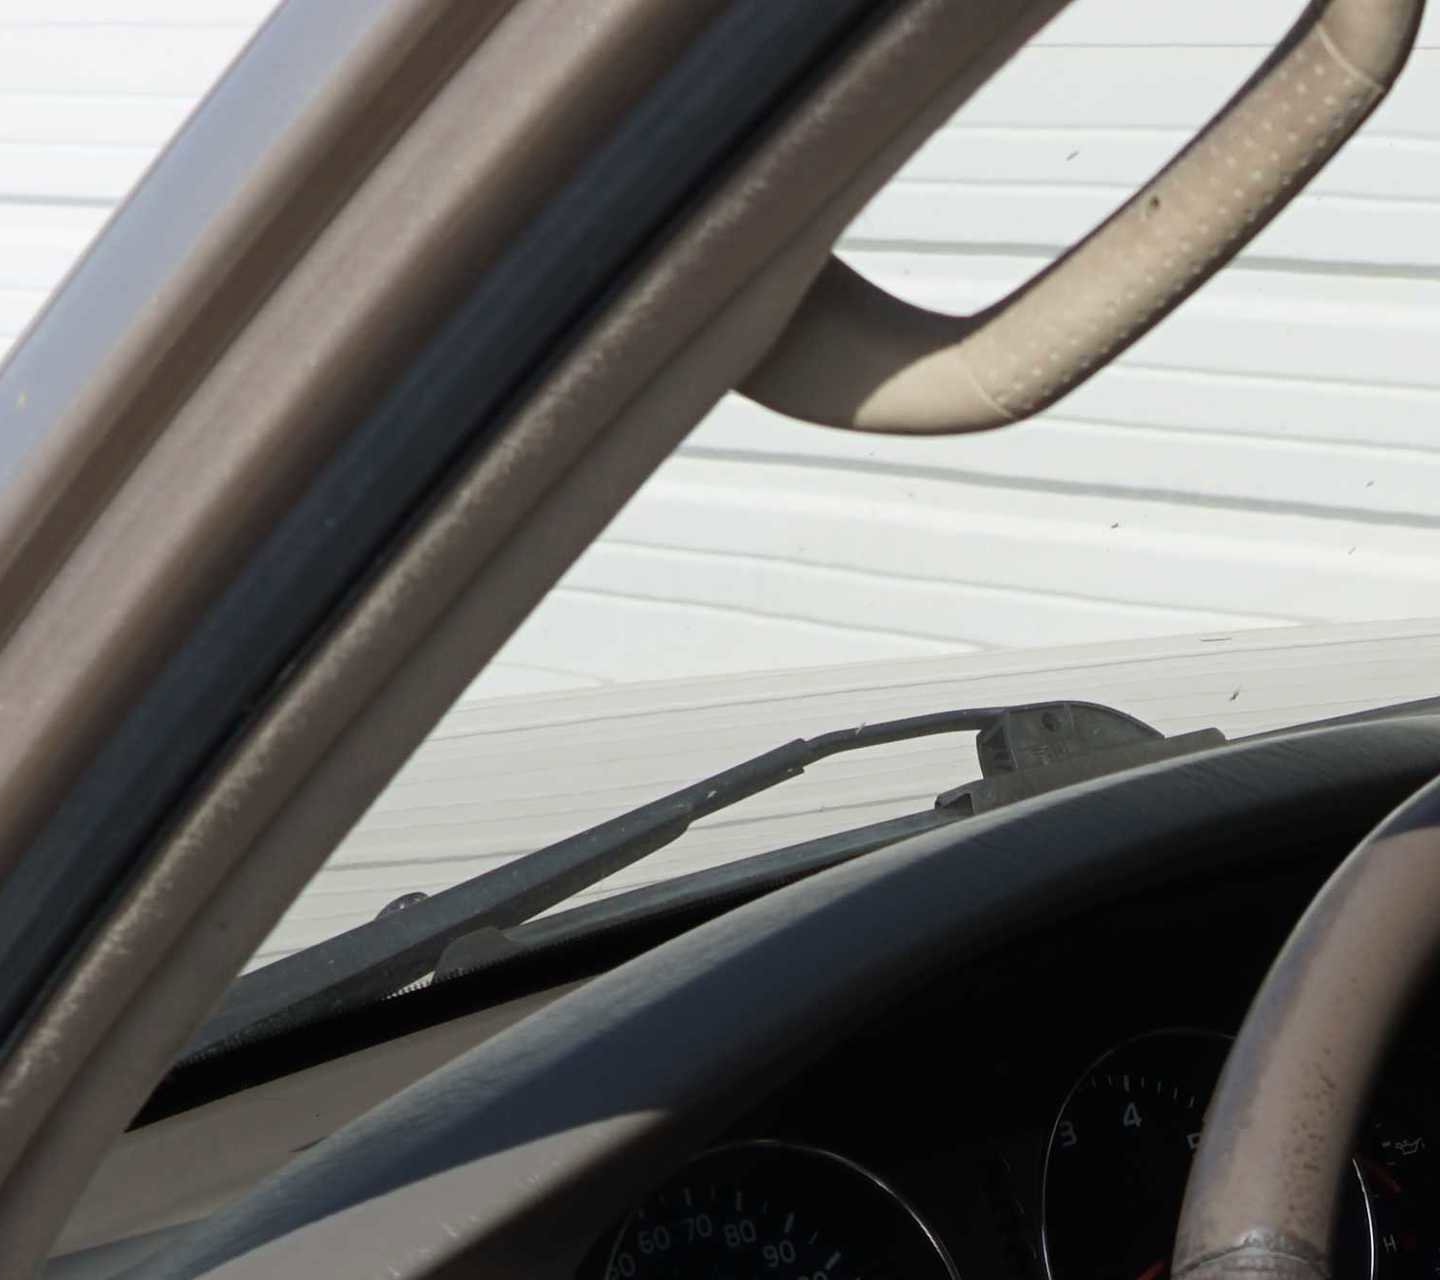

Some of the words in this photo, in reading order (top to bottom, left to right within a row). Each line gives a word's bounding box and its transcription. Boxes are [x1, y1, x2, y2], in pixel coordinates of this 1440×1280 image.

[1122, 1102, 1143, 1128] 4
[639, 1225, 671, 1254] 60
[683, 1214, 712, 1244] 70
[722, 1219, 757, 1248] 80
[1383, 1234, 1398, 1252] H
[762, 1240, 797, 1269] 90
